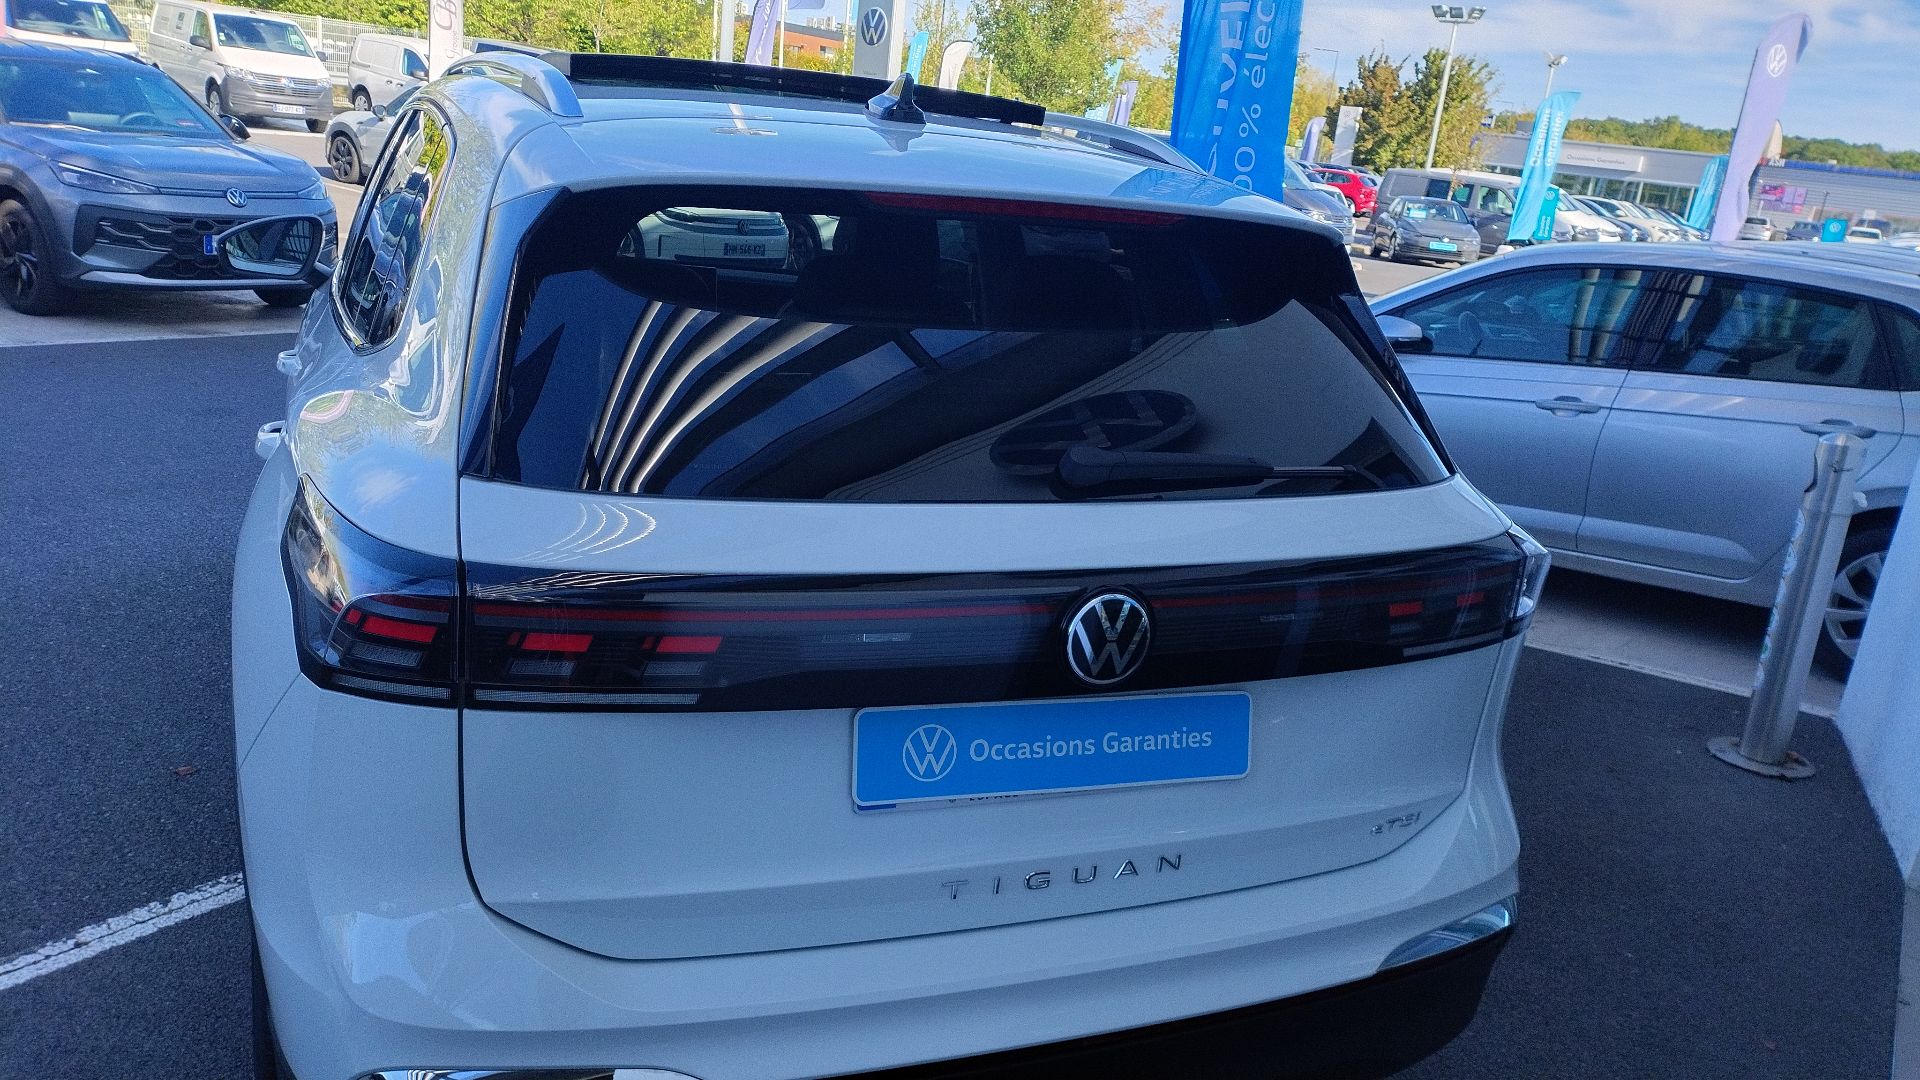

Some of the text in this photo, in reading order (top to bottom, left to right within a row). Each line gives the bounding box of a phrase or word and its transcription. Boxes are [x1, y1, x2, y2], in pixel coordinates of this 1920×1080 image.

[969, 734, 1096, 762] Occasions
[1102, 726, 1213, 755] Garanties
[941, 853, 1183, 900] TIGUAN
